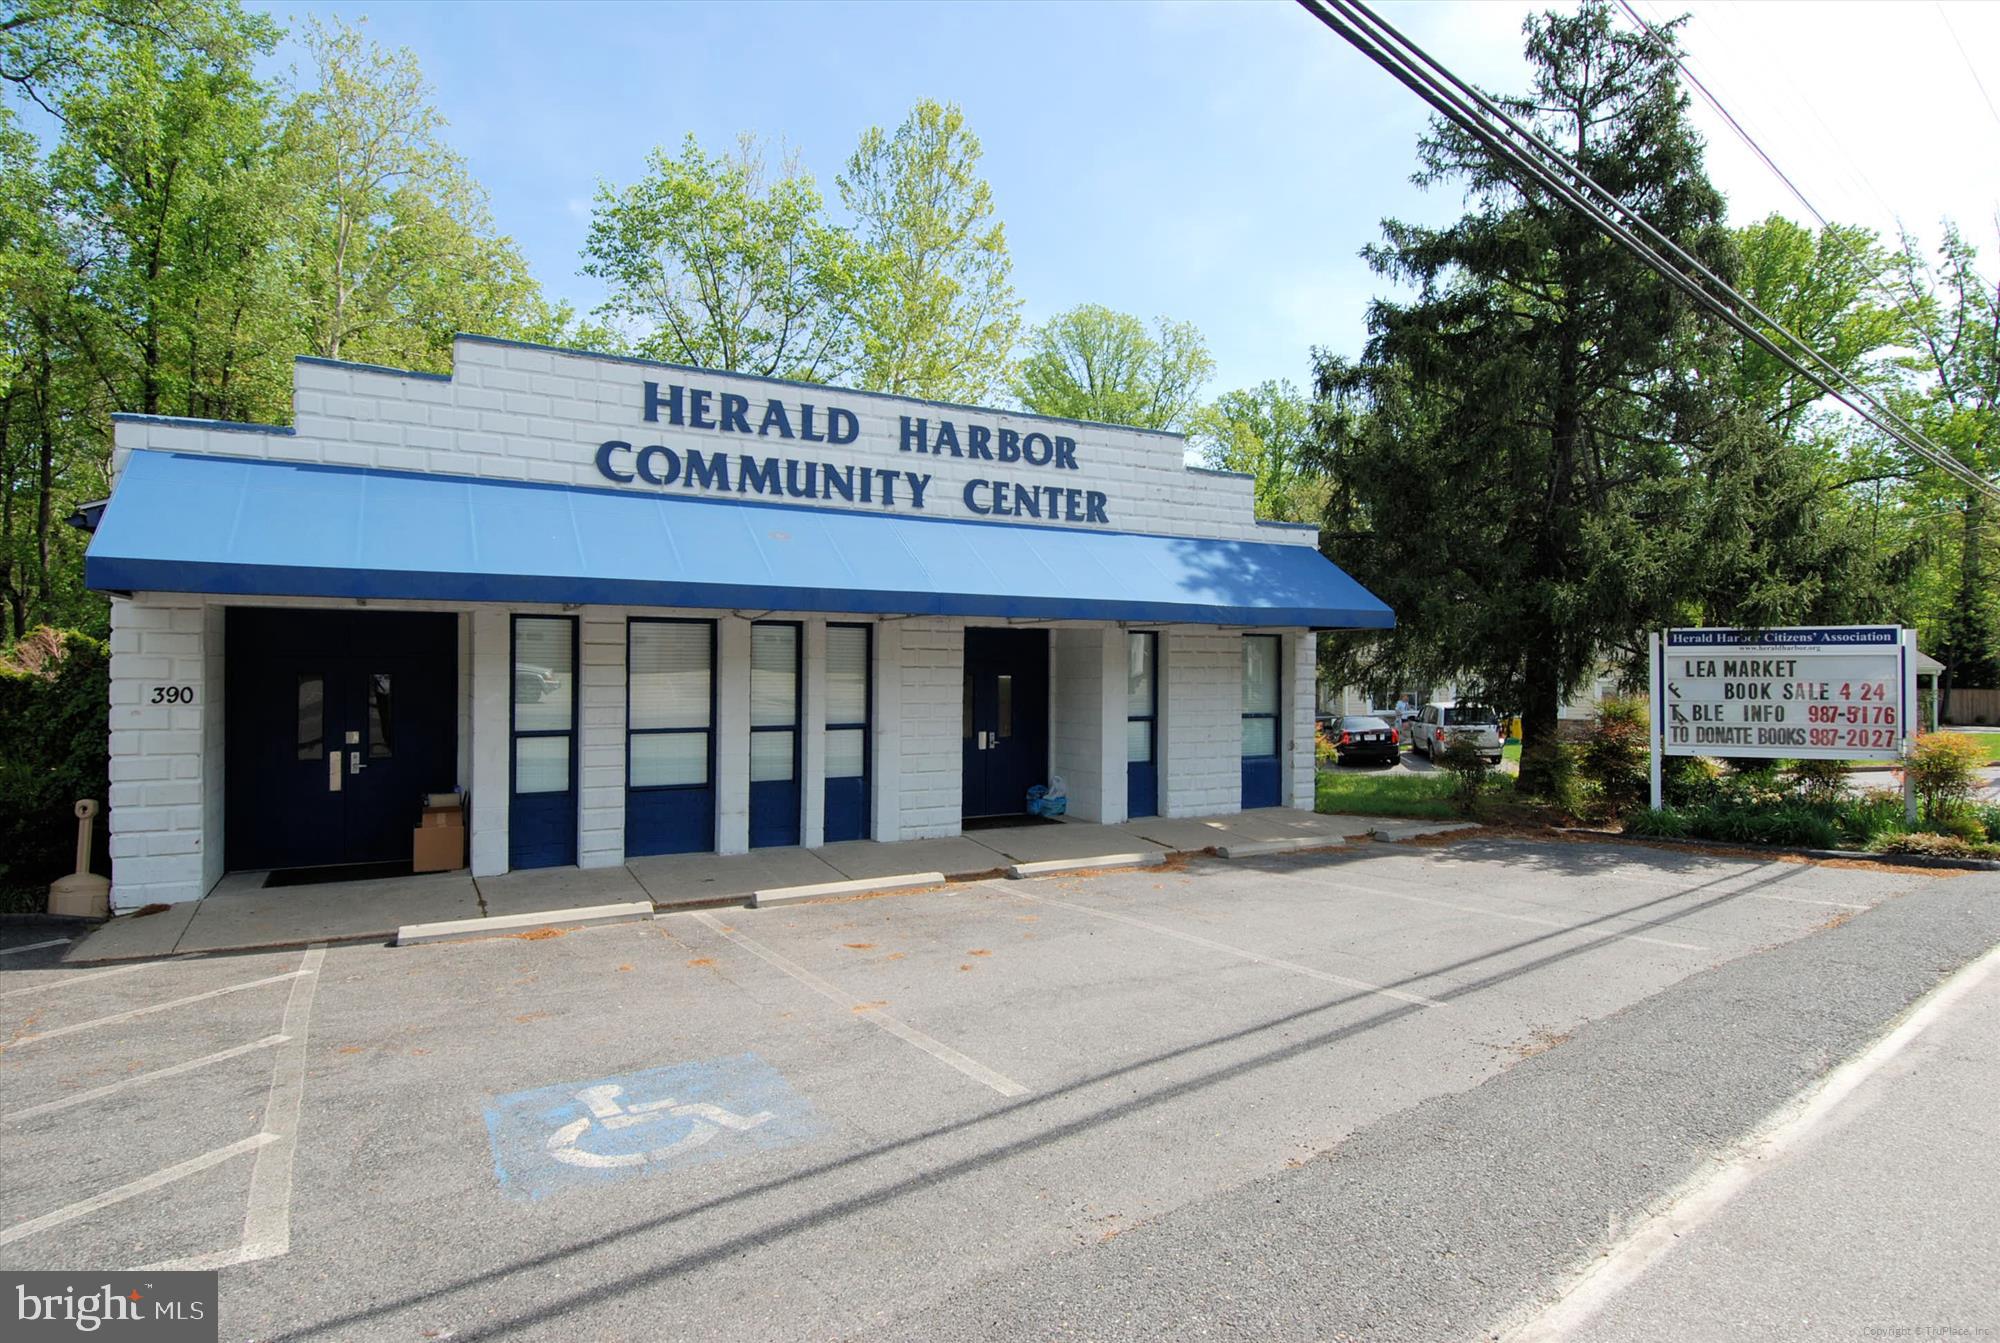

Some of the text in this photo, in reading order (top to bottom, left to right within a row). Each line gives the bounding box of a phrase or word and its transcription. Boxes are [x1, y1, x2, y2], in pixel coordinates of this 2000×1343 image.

[643, 381, 1079, 470] HERALD HARBOR
[595, 440, 1109, 523] COMMUNITY CENTER
[1673, 633, 1712, 643] Herald
[1821, 632, 1892, 642] Association
[1685, 660, 1797, 678] LEA MARKET
[151, 686, 194, 704] 390
[1724, 682, 1885, 701] BOOK SALE 4 24
[1743, 705, 1785, 722] INFO
[1808, 705, 1896, 725] 987-5176
[1670, 726, 1895, 748] TO DONATE BOOKS 987-2027
